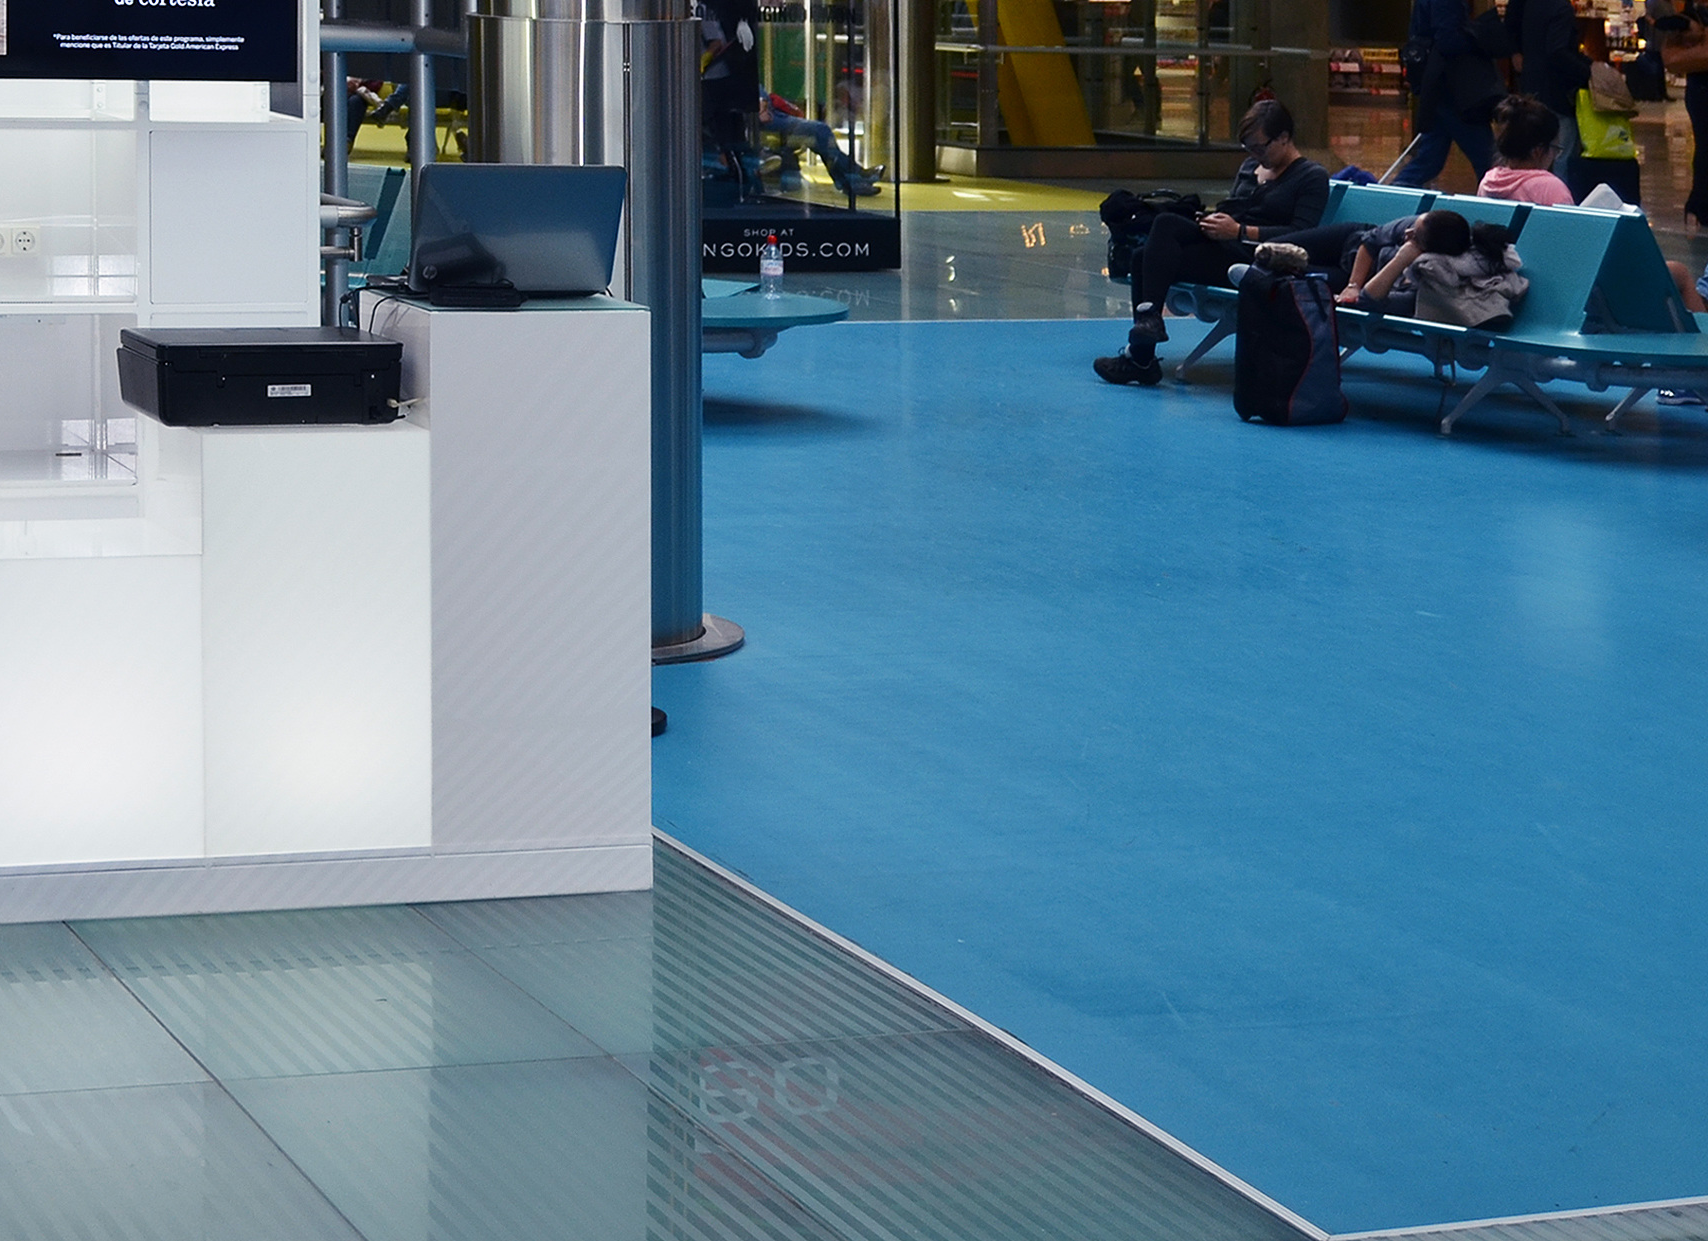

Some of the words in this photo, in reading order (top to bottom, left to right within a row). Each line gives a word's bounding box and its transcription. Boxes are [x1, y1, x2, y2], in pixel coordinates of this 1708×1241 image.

[185, 42, 214, 50] American
[215, 41, 239, 51] Express
[743, 228, 777, 237] SHOP
[779, 228, 795, 237] AT
[703, 242, 870, 258] NGOKDS.COM
